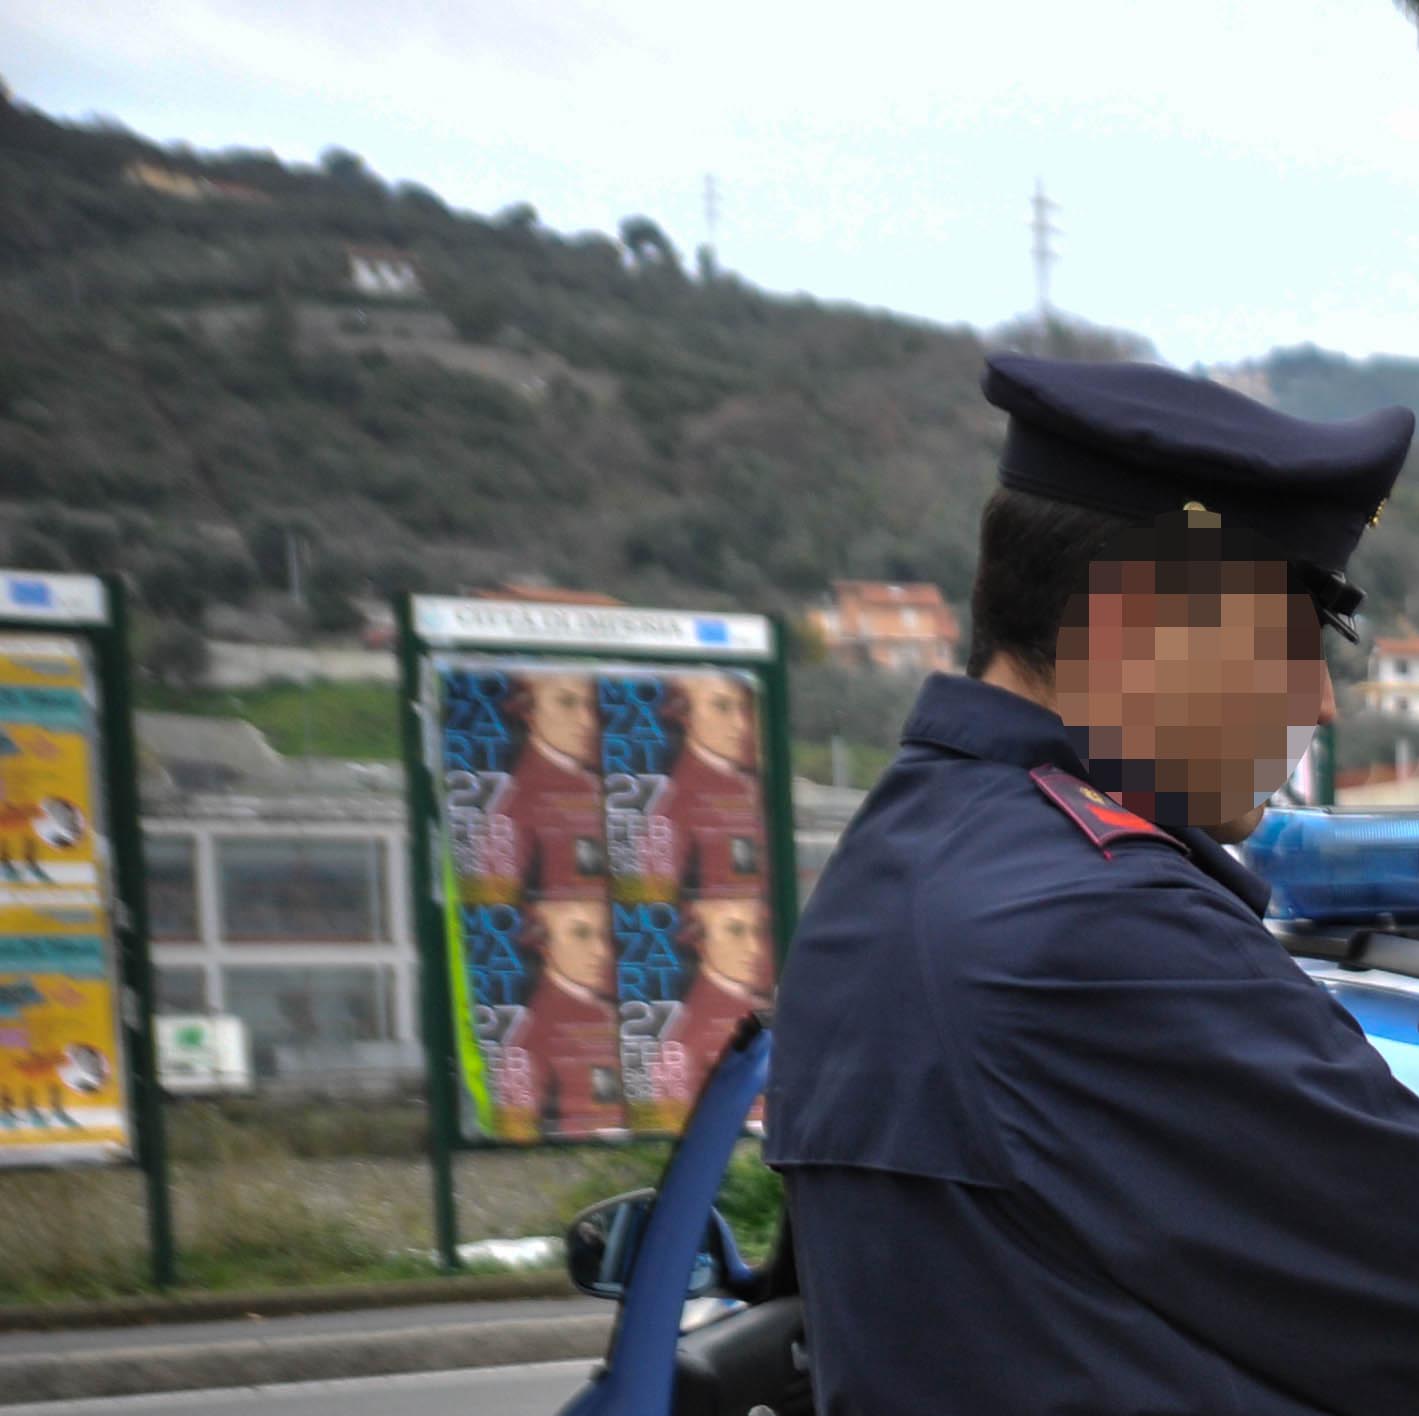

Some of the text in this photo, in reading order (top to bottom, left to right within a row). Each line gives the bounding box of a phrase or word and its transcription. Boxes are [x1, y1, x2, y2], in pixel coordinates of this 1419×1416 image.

[447, 771, 512, 813] 27
[605, 773, 672, 815] 27
[613, 902, 679, 934] MO
[619, 1000, 685, 1040] 27
[621, 1038, 686, 1068] FEB
